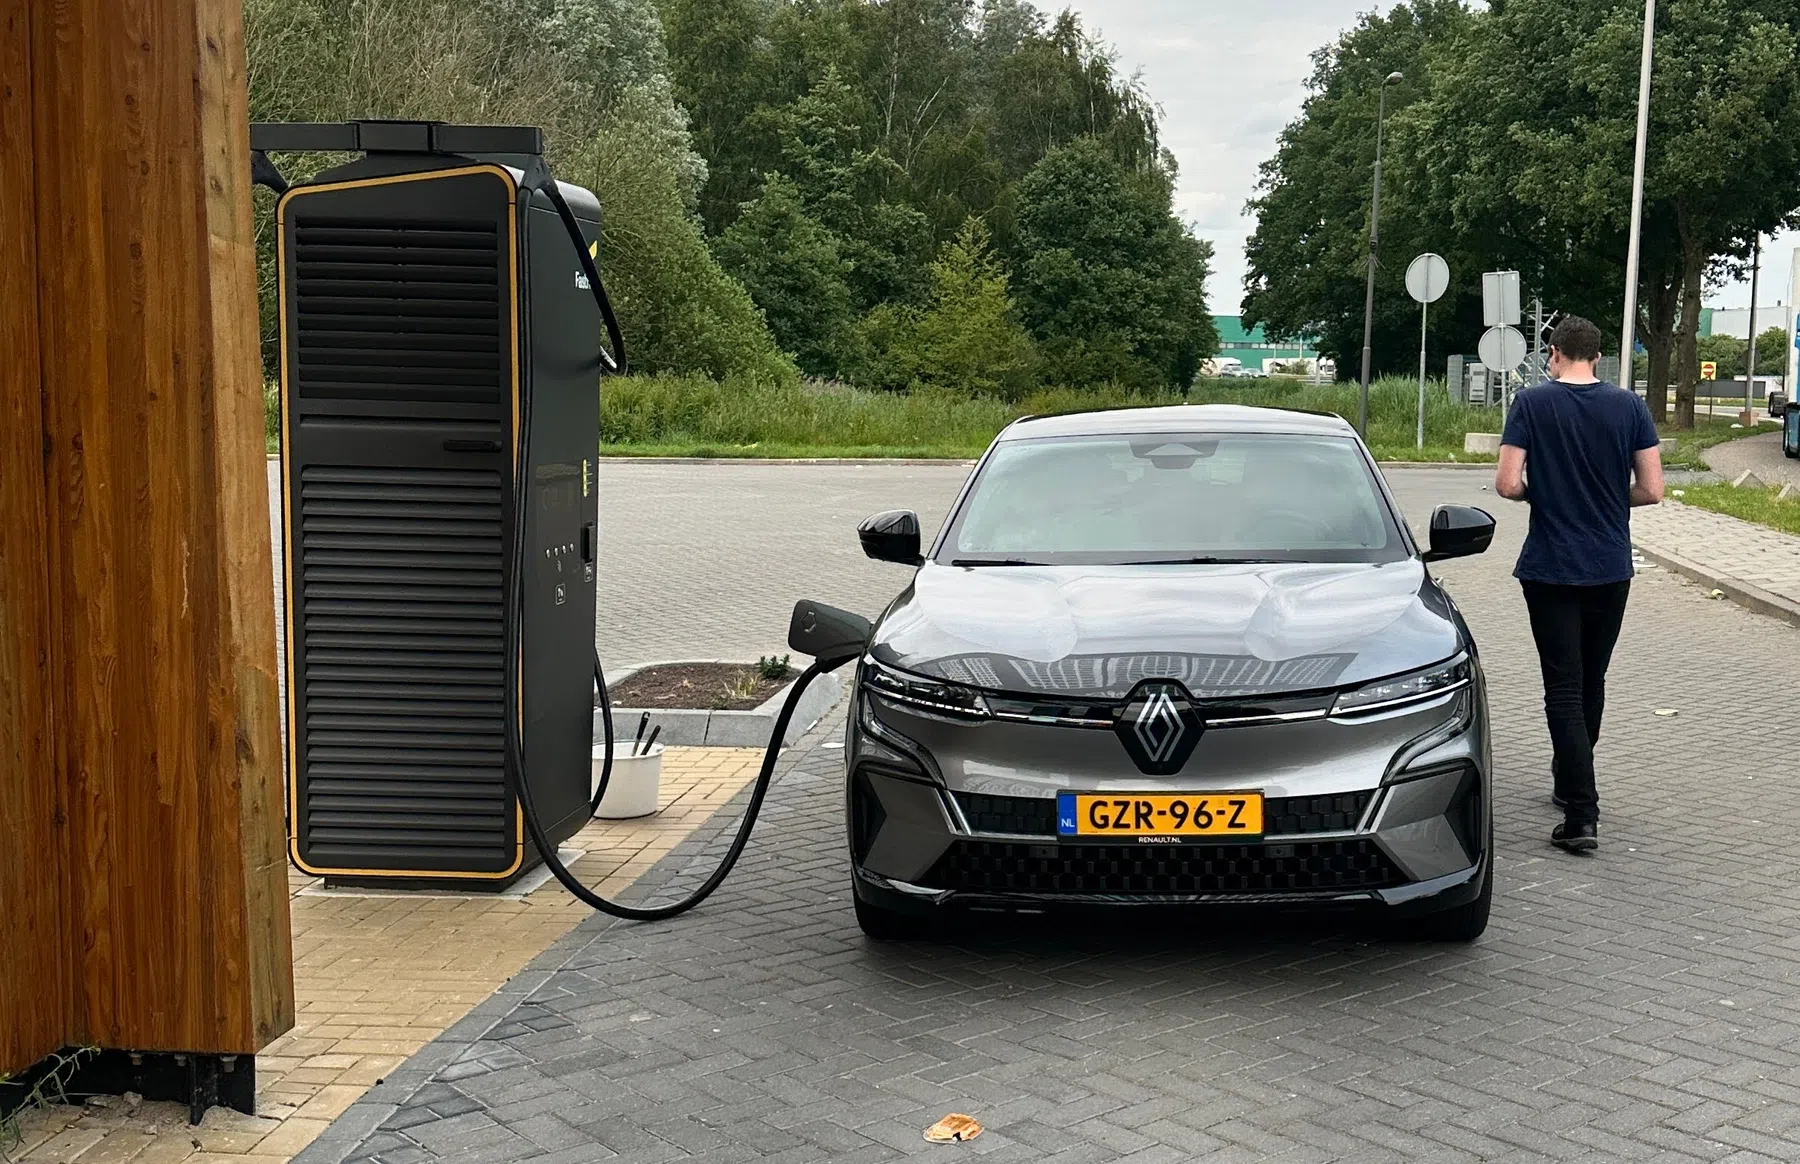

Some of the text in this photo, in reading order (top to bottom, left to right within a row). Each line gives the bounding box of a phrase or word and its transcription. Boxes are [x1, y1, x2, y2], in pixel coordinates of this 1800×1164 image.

[1089, 800, 1246, 829] GZR-96-Z
[1061, 818, 1075, 828] NL
[1138, 836, 1182, 844] RENAULT.NL
